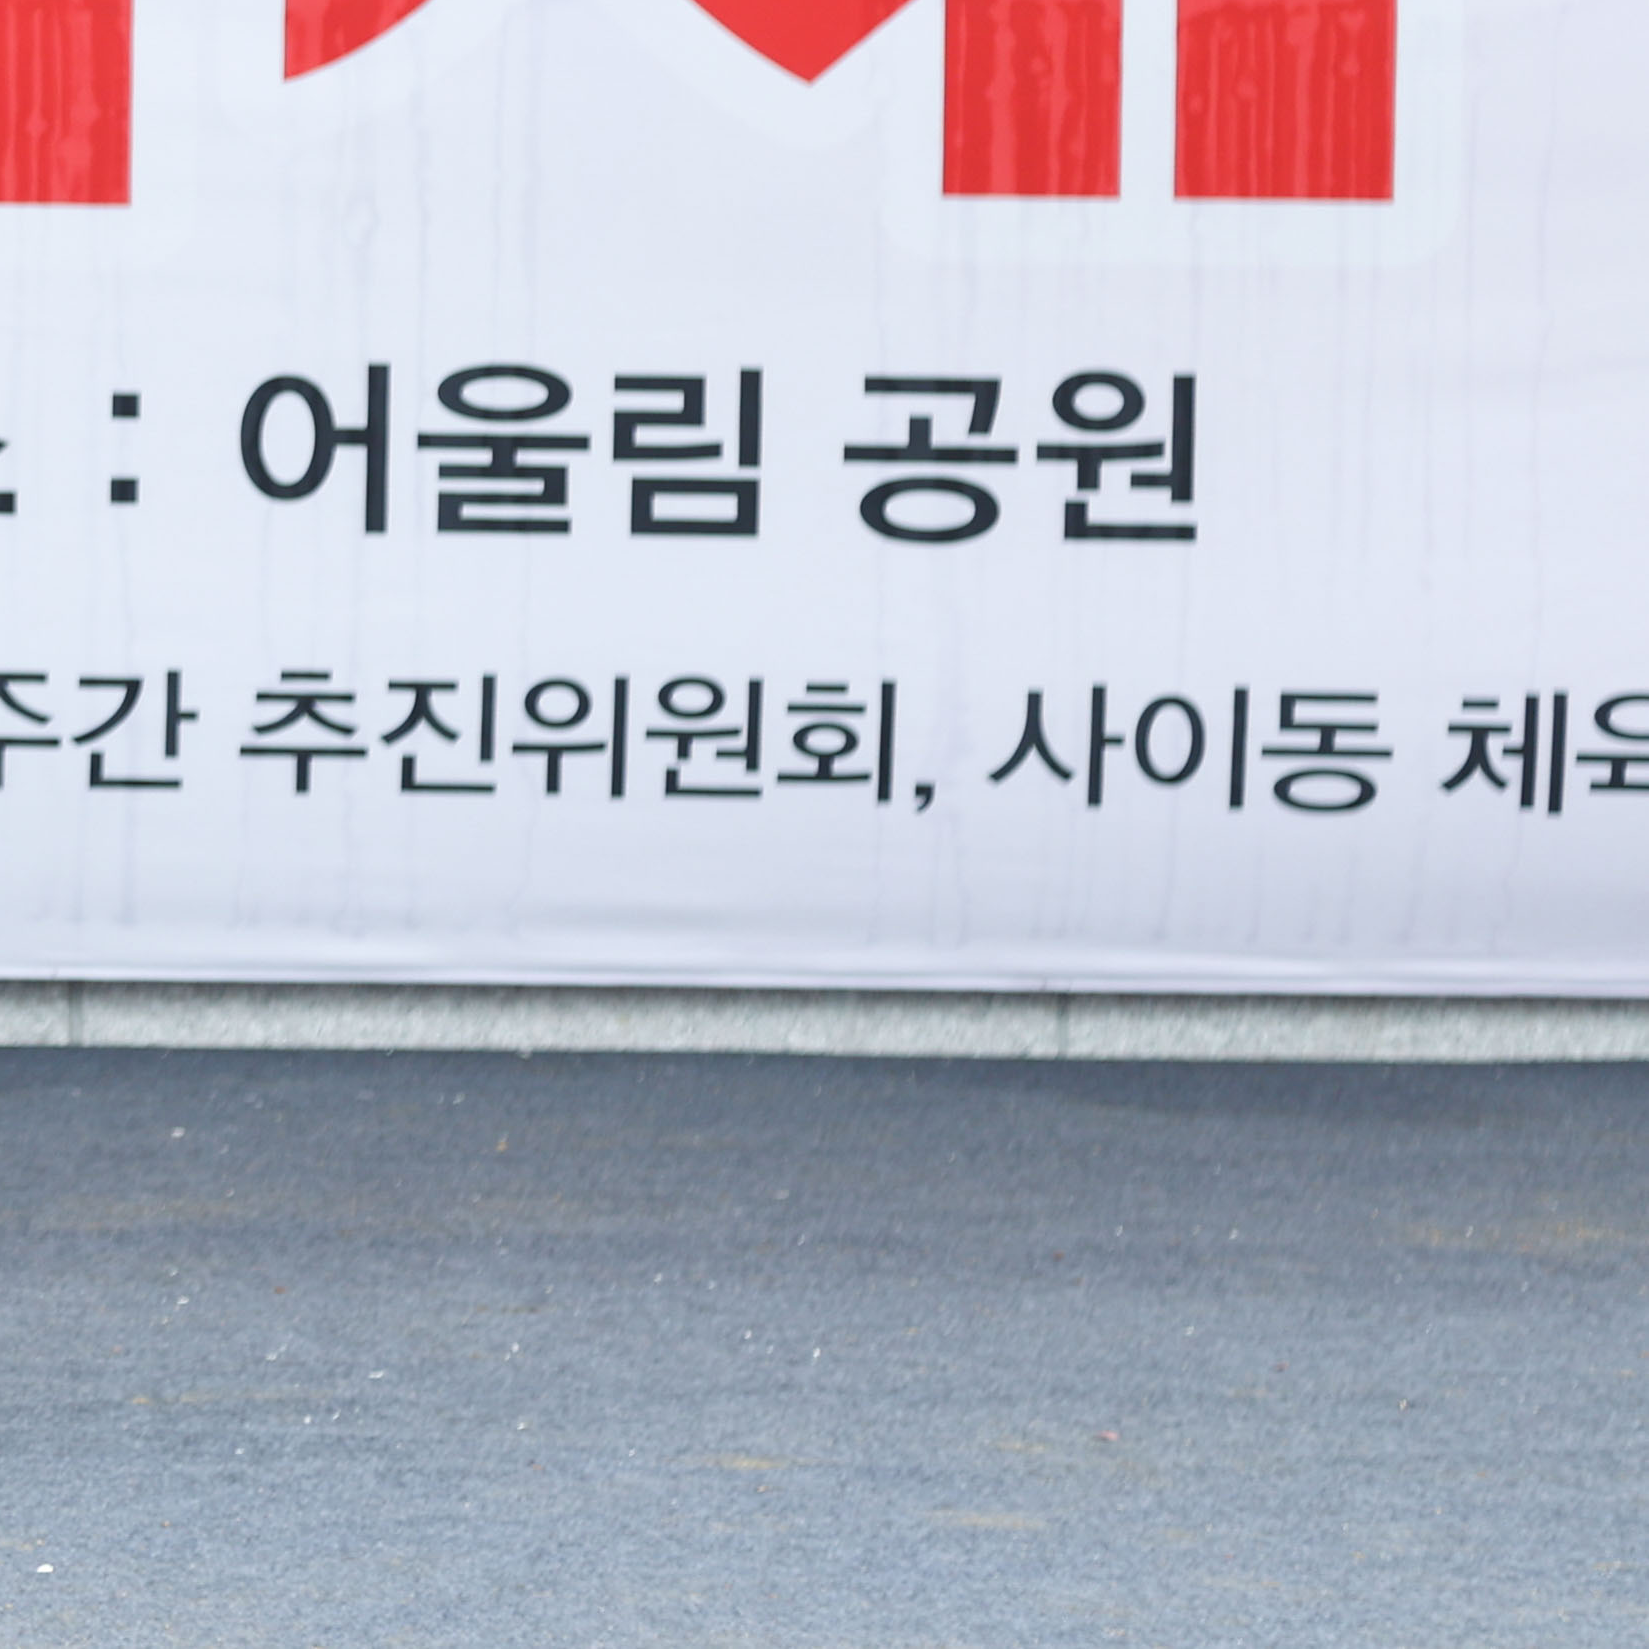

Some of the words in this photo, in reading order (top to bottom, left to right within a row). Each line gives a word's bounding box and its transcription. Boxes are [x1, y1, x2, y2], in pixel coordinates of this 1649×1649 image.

[110, 393, 139, 503] :
[240, 364, 762, 536] 어울림
[843, 372, 1197, 543] 공원
[239, 671, 934, 810] 추진위원회,
[989, 685, 1393, 812] 사이동
